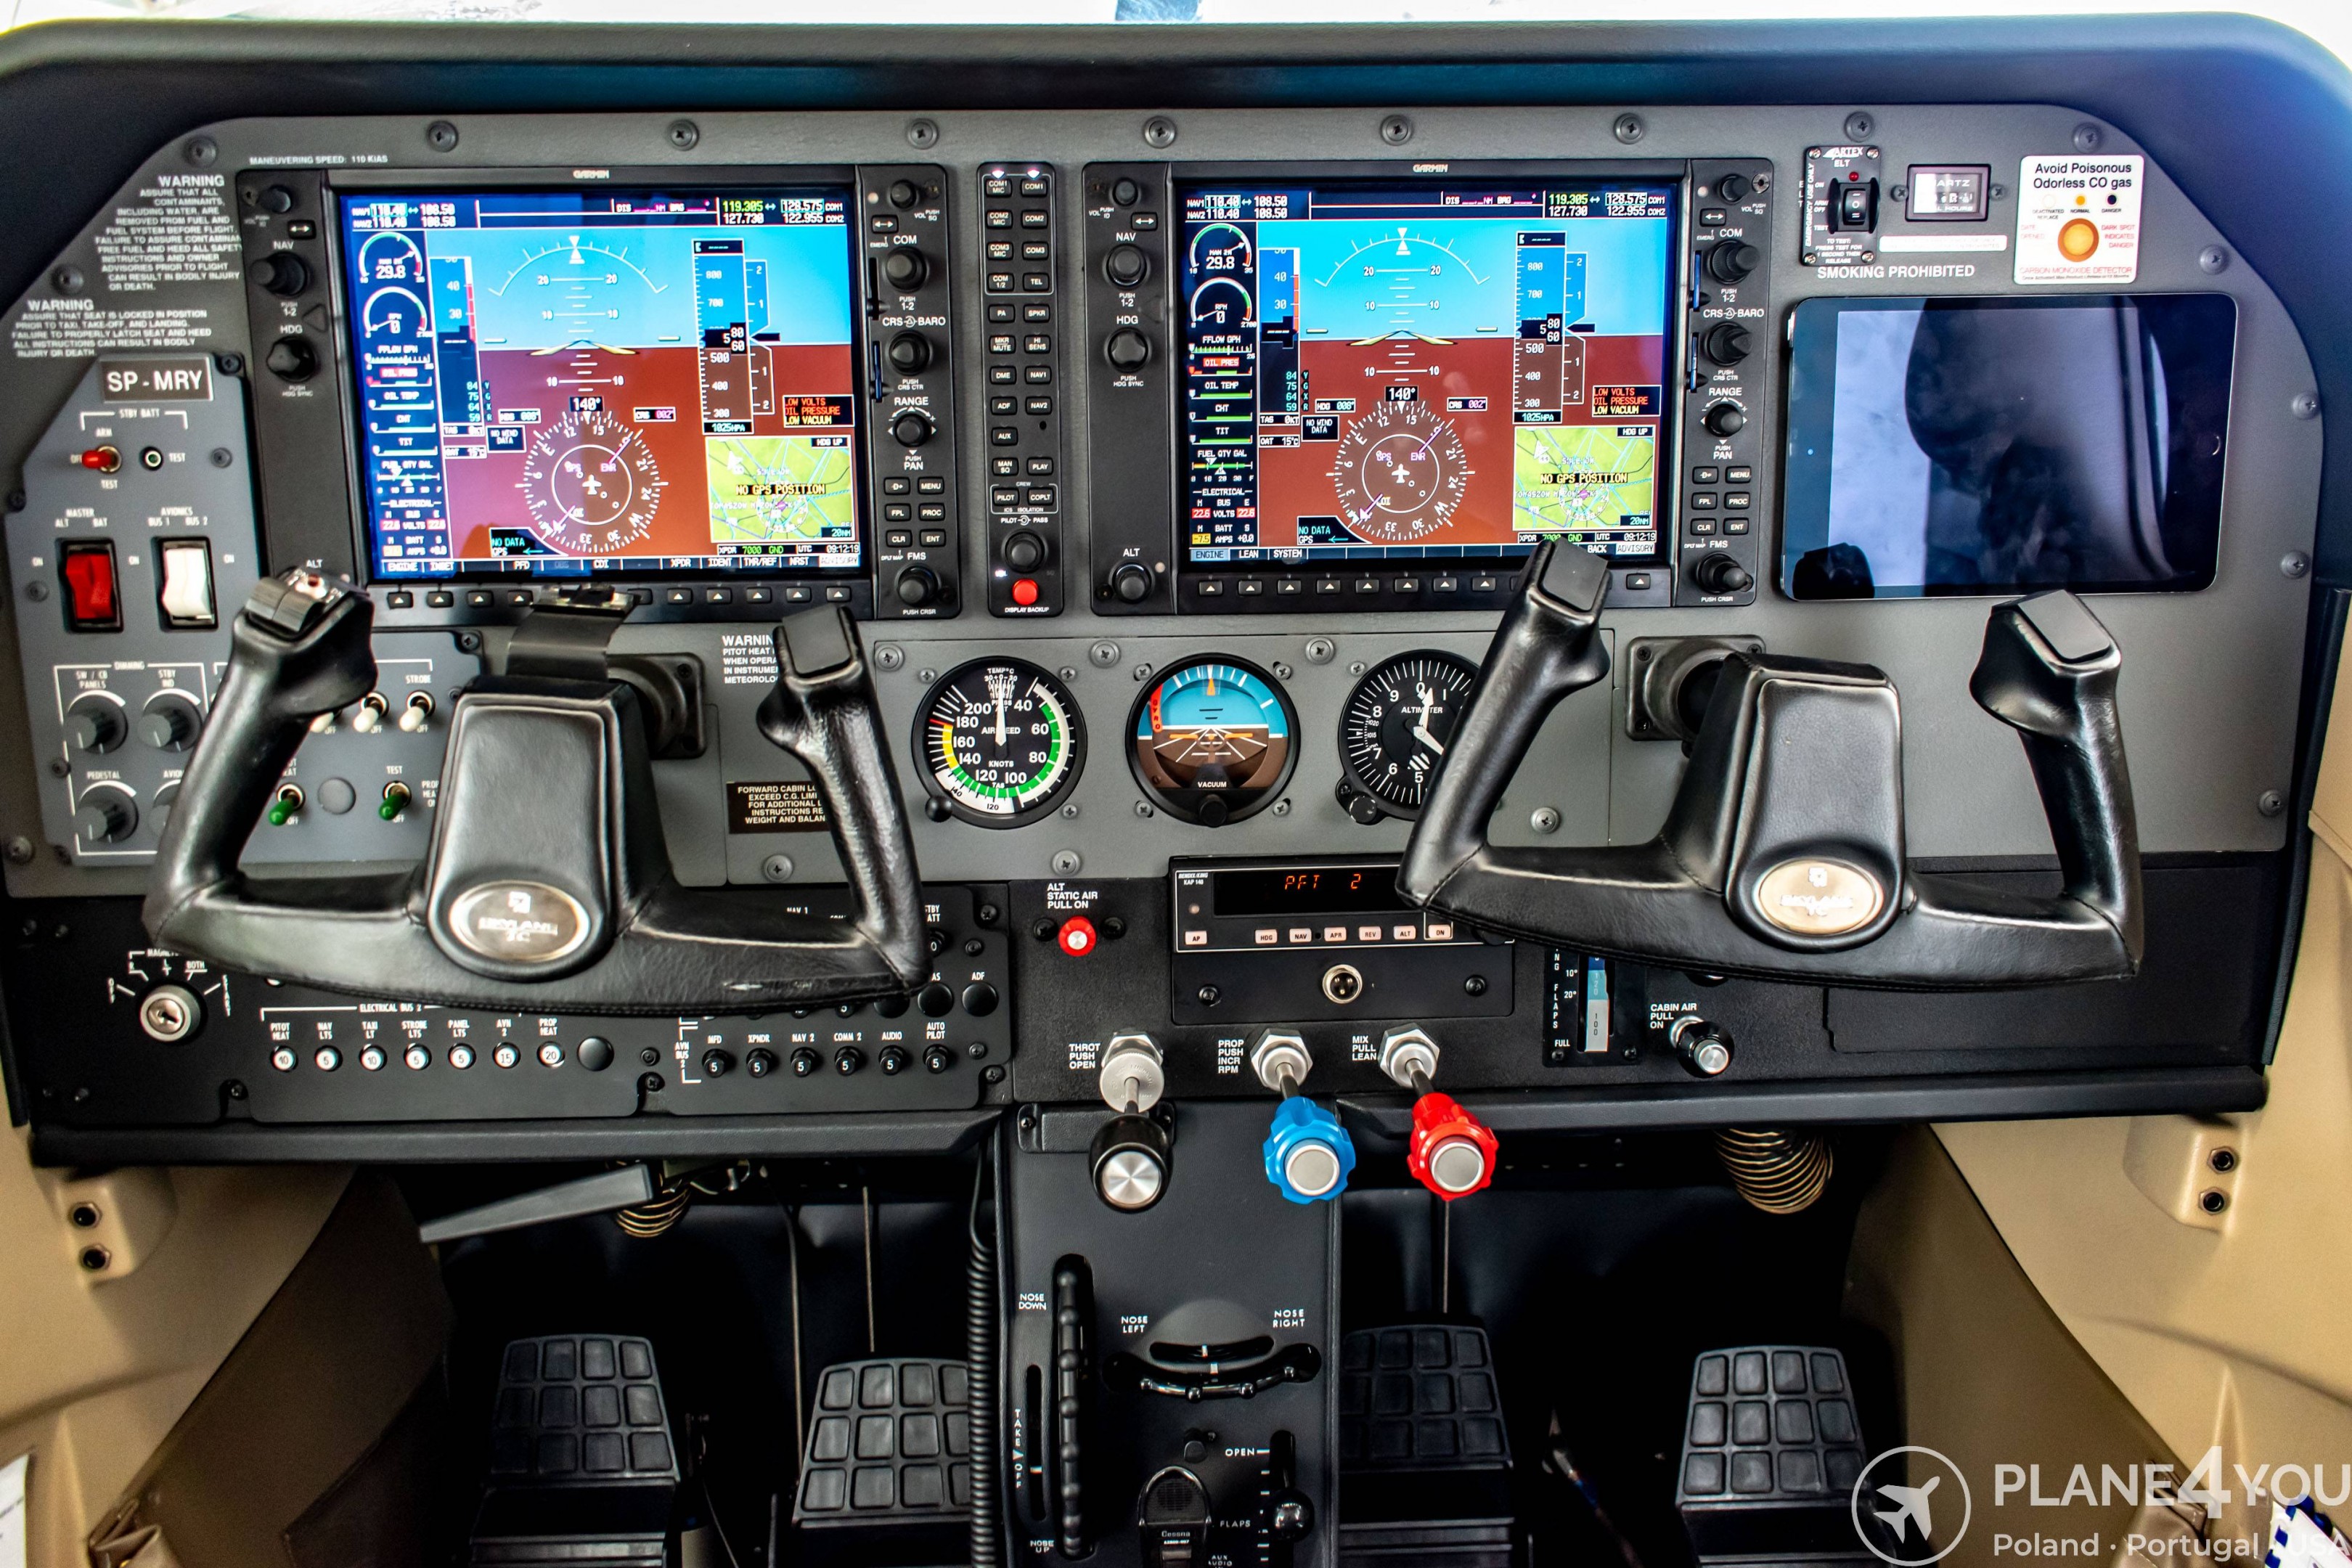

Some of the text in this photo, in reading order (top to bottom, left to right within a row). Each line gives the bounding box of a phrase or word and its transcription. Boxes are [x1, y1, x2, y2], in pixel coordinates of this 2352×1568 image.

[250, 156, 314, 165] MANEUVERING
[1413, 164, 1447, 173] GARMIN
[2035, 163, 2131, 173] Avoid Poisonous
[158, 176, 224, 187] WARNING
[2033, 177, 2131, 189] Odorless CO gas
[1254, 196, 1288, 207] 108.50
[1549, 194, 1646, 205] 119.305 128.575
[1254, 208, 1288, 219] 108.50
[1549, 205, 1646, 216] 127.730 122.955
[893, 235, 917, 244] COM
[1206, 257, 1235, 269] 29.8
[1818, 265, 1975, 279] SMOKING PROHIBITED
[28, 300, 94, 311] WARNING
[883, 317, 903, 326] CRS
[141, 409, 159, 417] BATT
[904, 462, 923, 470] PAN
[736, 484, 825, 495] NO GPS POSITION
[66, 508, 94, 518] MASTER
[160, 507, 192, 516] AVIONICS
[1624, 532, 1655, 541] 09:12:19
[1588, 544, 1606, 553] BACK
[1617, 544, 1654, 553] ADVISORY
[1196, 550, 1224, 559] ENGINE
[708, 558, 732, 567] IDENT
[722, 635, 772, 645] WARNIN
[965, 703, 991, 714] 200
[1014, 700, 1032, 711] 40
[1373, 706, 1382, 717] 8
[957, 716, 979, 727] 180
[1032, 724, 1049, 734] 60
[953, 737, 975, 748] 160
[1029, 752, 1046, 763] 80
[1005, 772, 1026, 784] 100
[1415, 772, 1423, 783] 5
[1285, 874, 1360, 889] PFT 2
[1048, 900, 1072, 909] PULL
[401, 1021, 427, 1029] STROBE
[448, 1020, 469, 1029] PANEL
[708, 1035, 722, 1044] MFD
[834, 1032, 862, 1042] COMM 2
[882, 1032, 902, 1041] AUDIO
[1018, 1302, 1047, 1310] DOWN
[1273, 1318, 1305, 1327] RIGHT
[1123, 1324, 1144, 1334] LEFT
